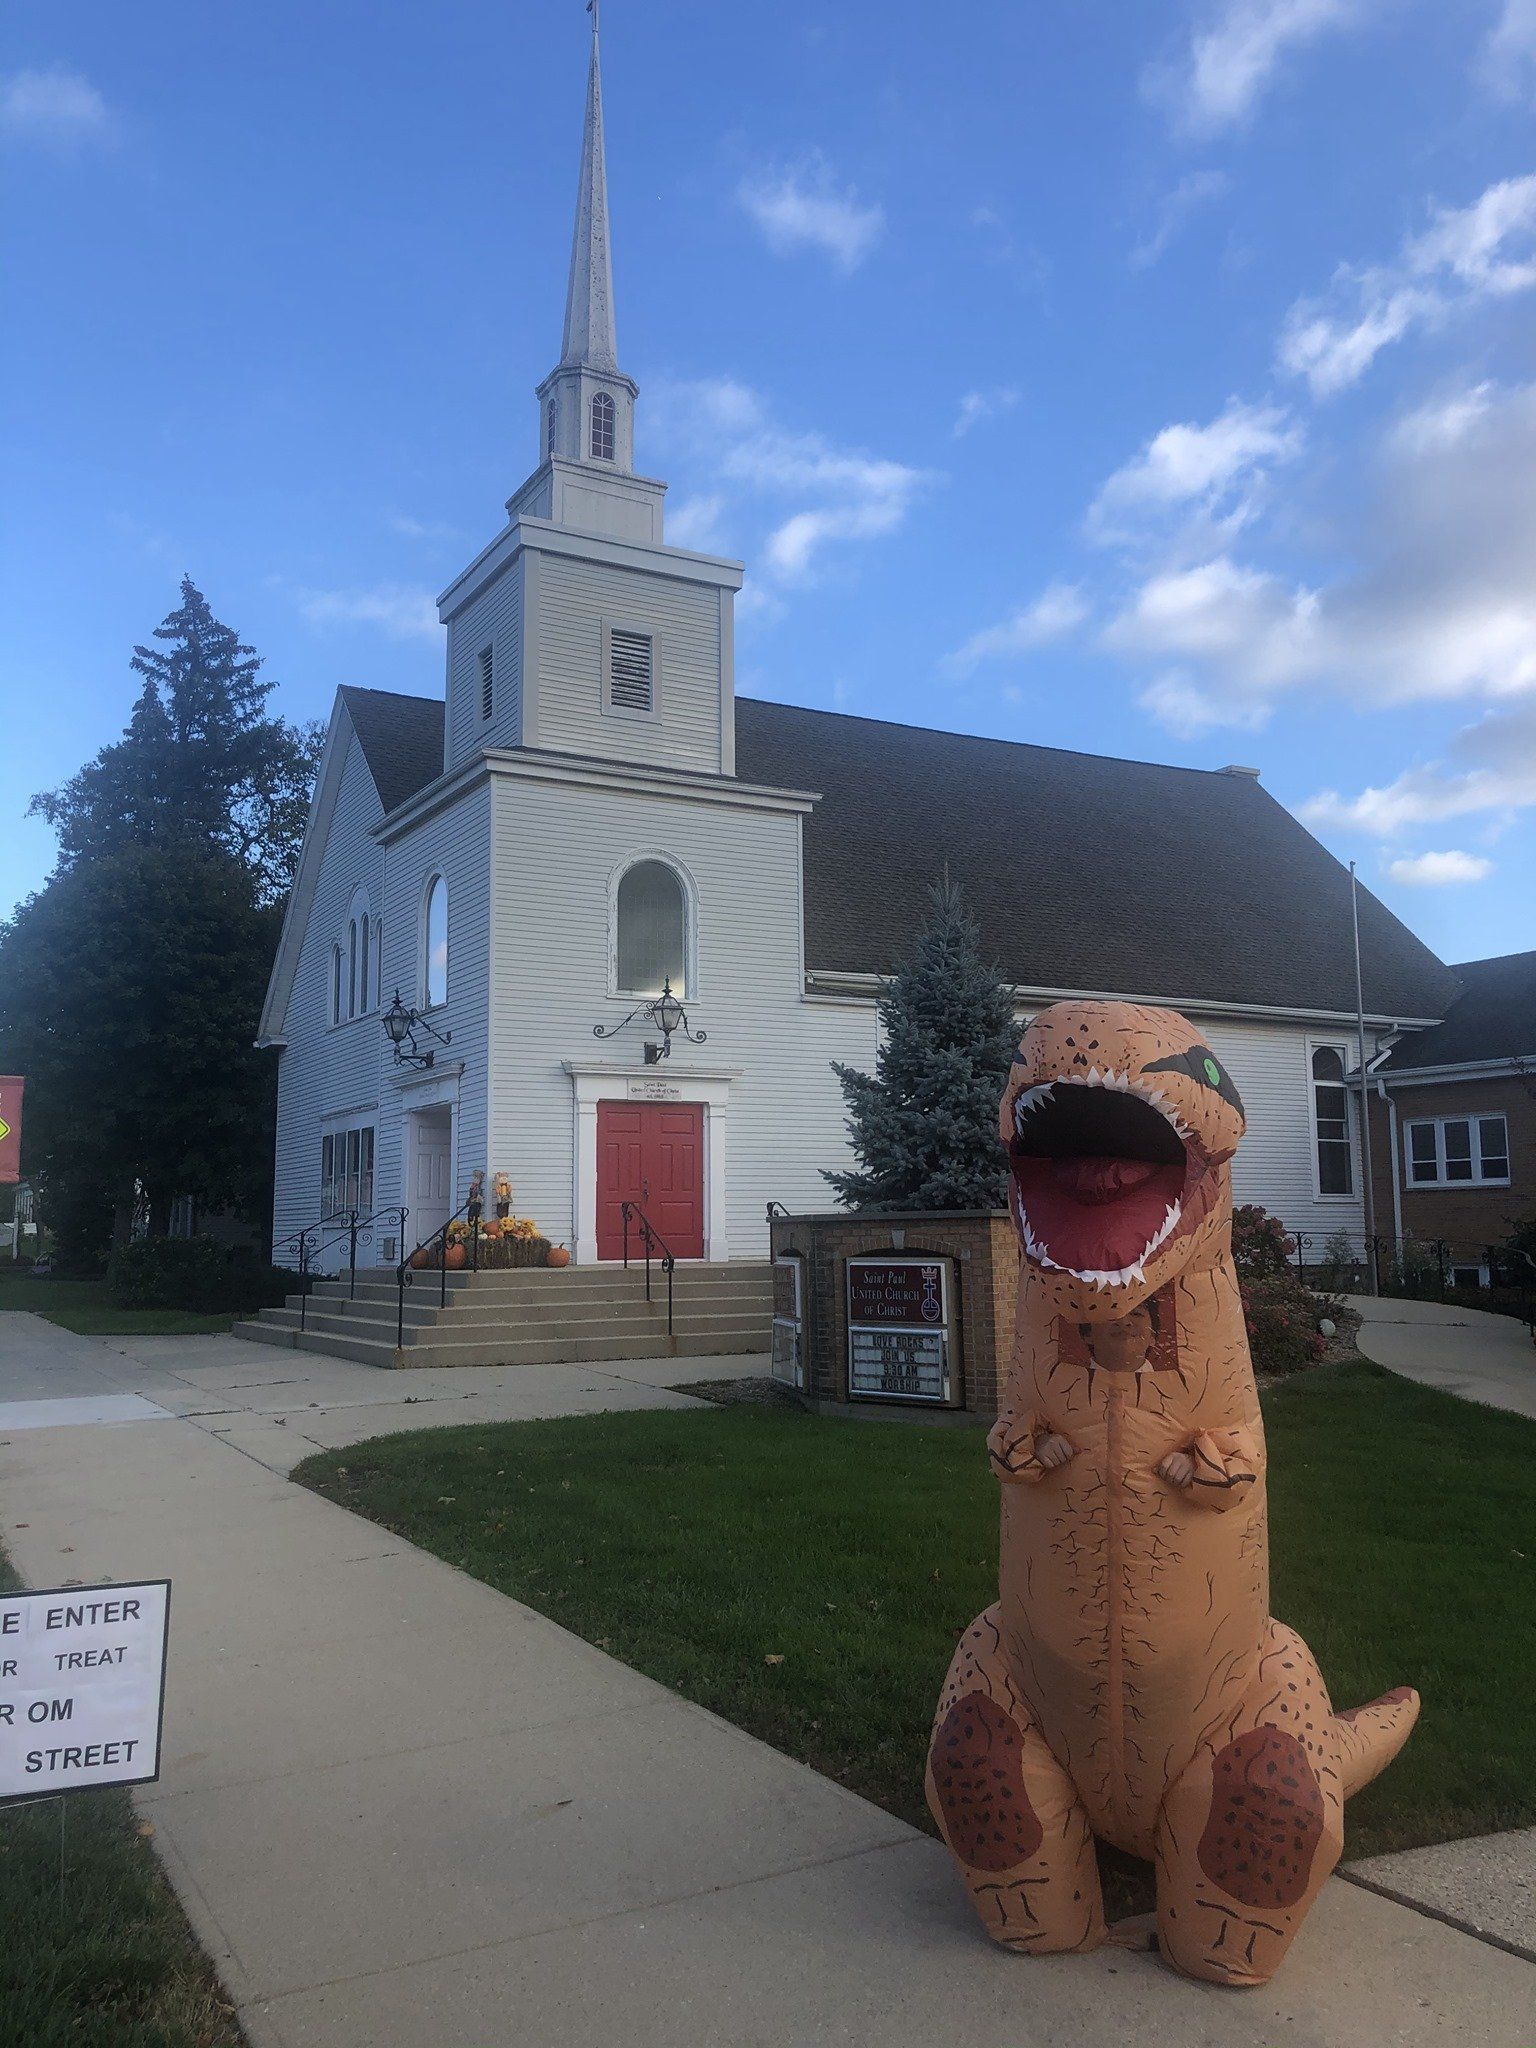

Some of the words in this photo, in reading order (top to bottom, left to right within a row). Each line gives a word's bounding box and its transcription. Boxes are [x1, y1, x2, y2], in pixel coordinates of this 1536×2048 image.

[863, 1270, 884, 1284] Saint
[888, 1270, 907, 1284] Paul
[852, 1286, 882, 1300] UNITED
[885, 1286, 920, 1301] CHURCH
[877, 1302, 908, 1317] CHRIST
[872, 1335, 893, 1347] LOVE
[896, 1336, 924, 1348] ROCKS
[881, 1349, 900, 1361] JOIN
[904, 1351, 916, 1362] US
[883, 1364, 903, 1376] 9:30
[905, 1365, 918, 1377] AM
[881, 1379, 920, 1391] WORSHIP
[46, 1600, 141, 1630] ENTER
[0, 1659, 18, 1677] R
[54, 1646, 128, 1671] TREAT
[25, 1739, 139, 1773] STREET
